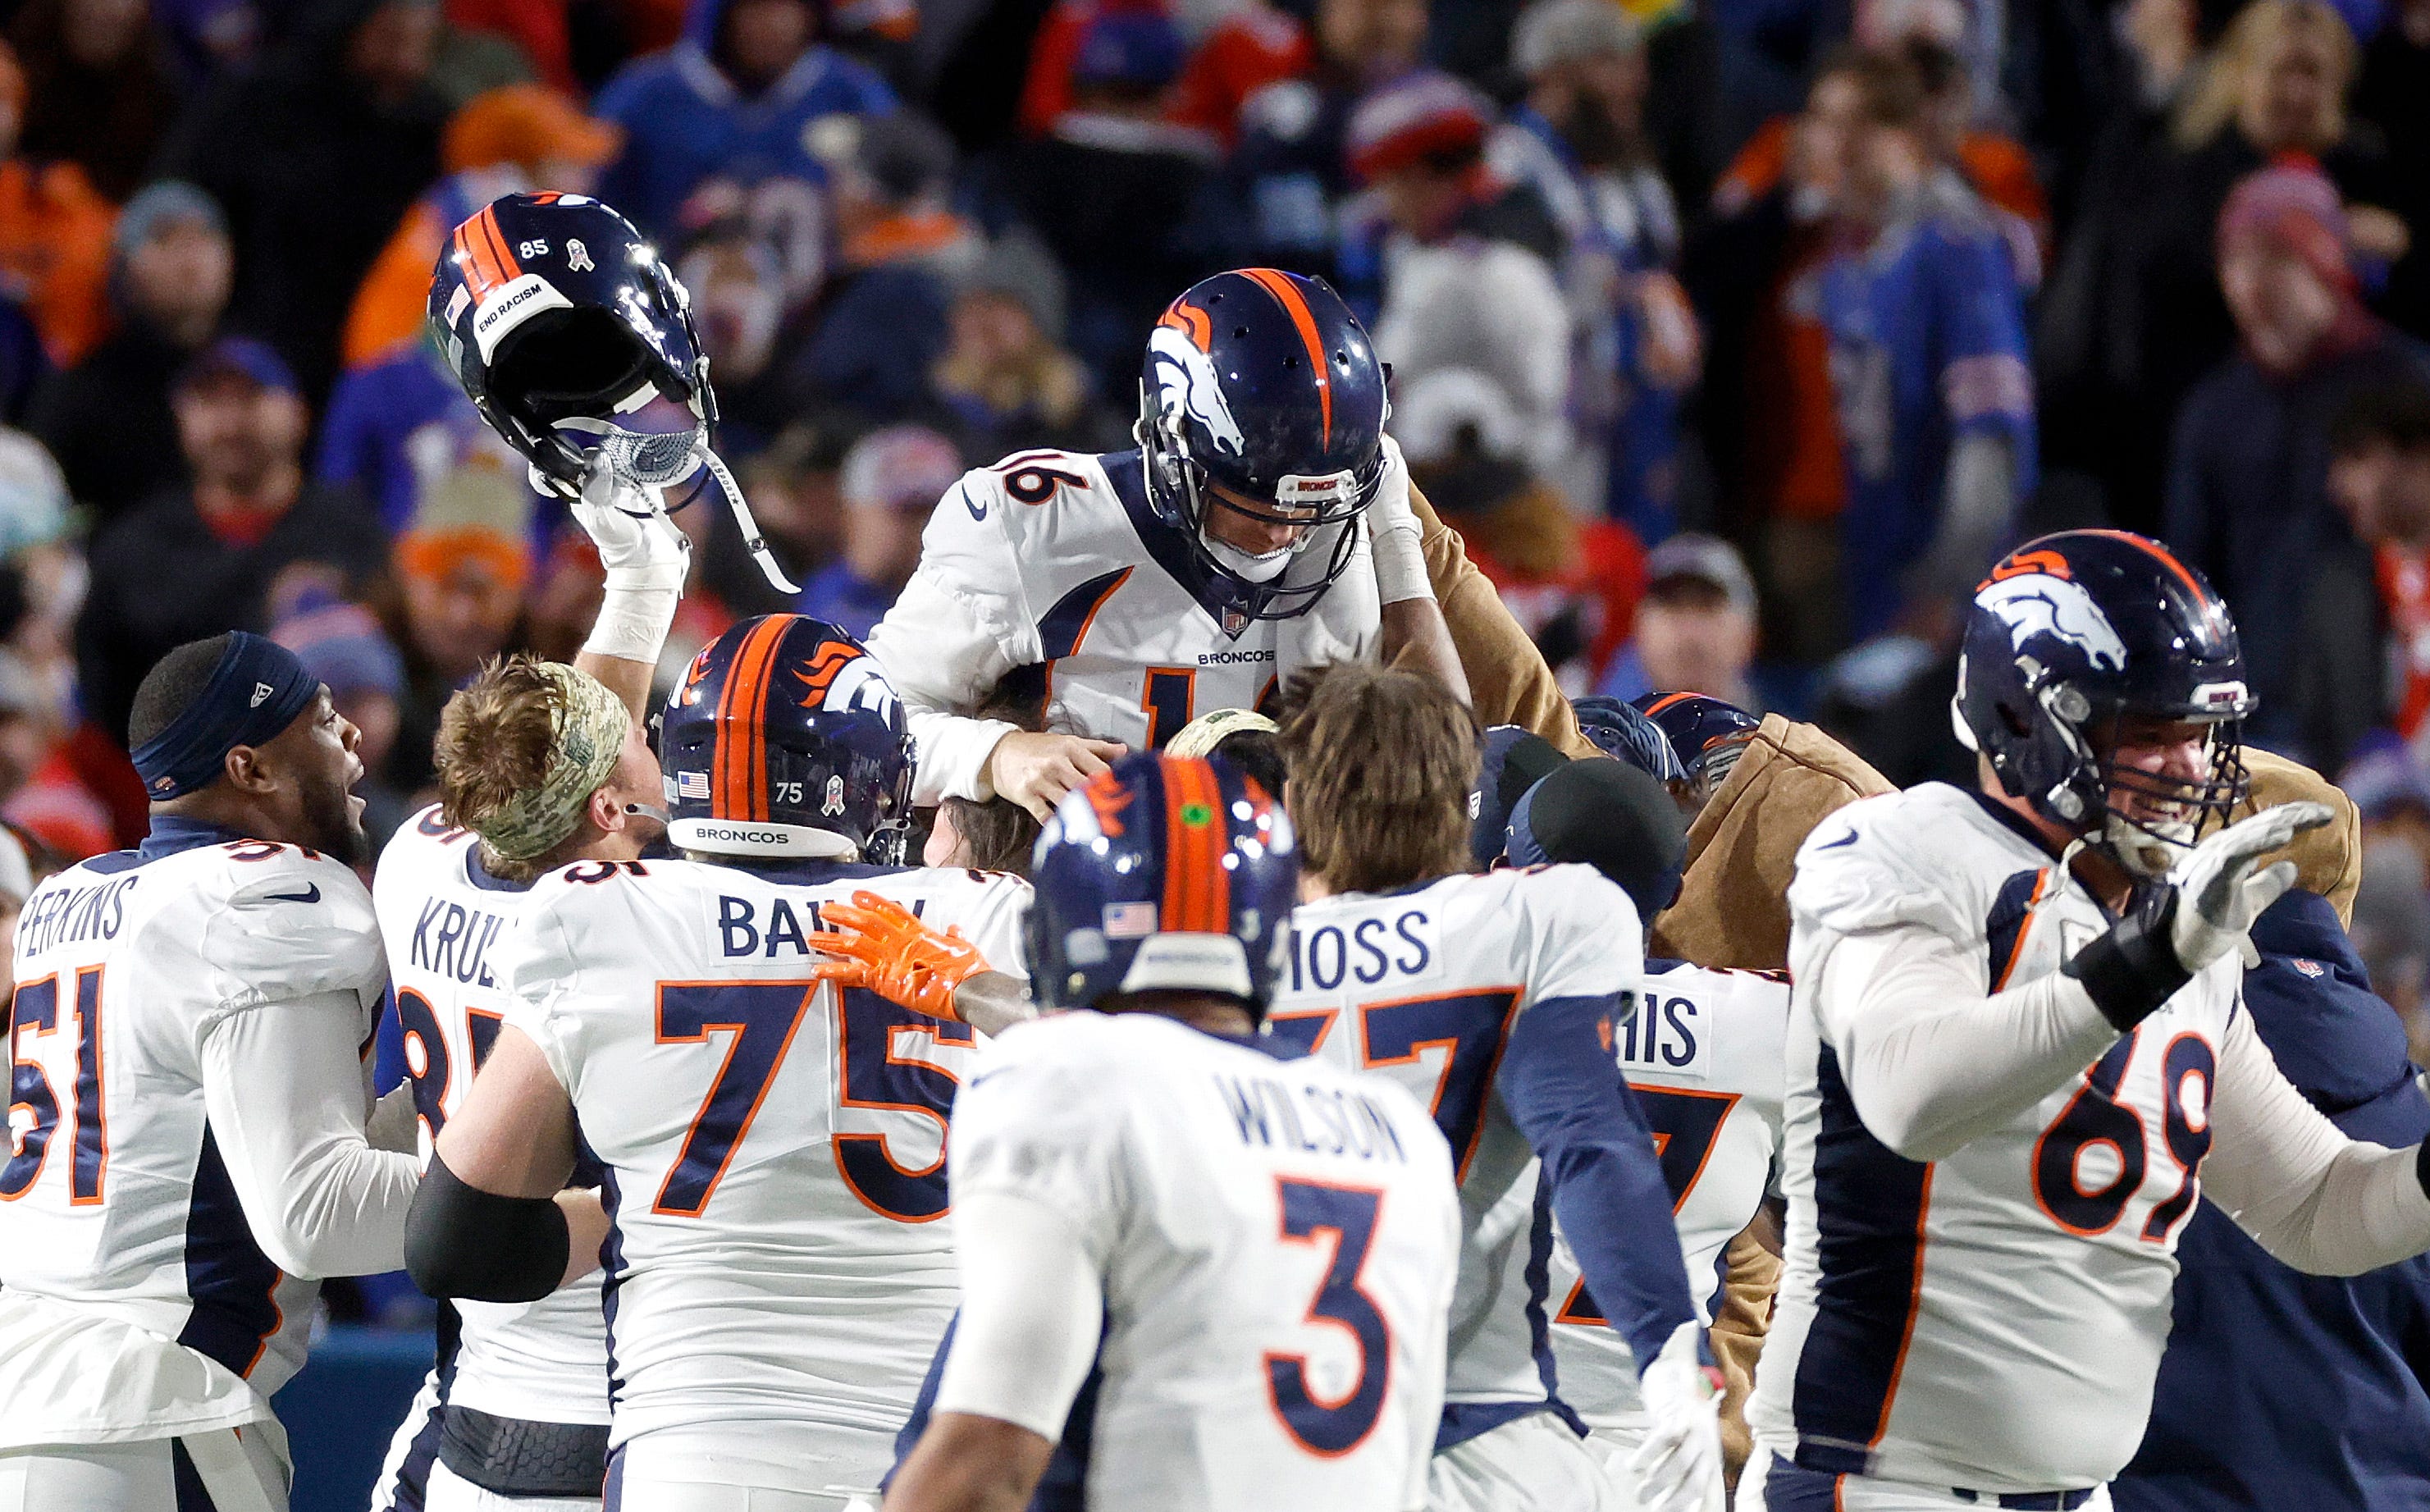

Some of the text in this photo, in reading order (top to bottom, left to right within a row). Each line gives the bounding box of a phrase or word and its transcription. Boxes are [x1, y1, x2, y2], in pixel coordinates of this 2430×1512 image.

[519, 239, 549, 259] 85
[479, 284, 542, 332] END RACISM
[988, 453, 1092, 505] 16
[1198, 650, 1275, 665] BRONCOS
[697, 828, 789, 844] BRONCOS
[776, 782, 804, 803] 75
[16, 875, 138, 964] PERKINS
[411, 895, 518, 989] KRUL
[0, 962, 109, 1207] 51
[651, 980, 977, 1223] 75
[1213, 1073, 1410, 1165] WILSON
[2030, 1022, 2217, 1245] 69
[1262, 1173, 1393, 1460] 3
